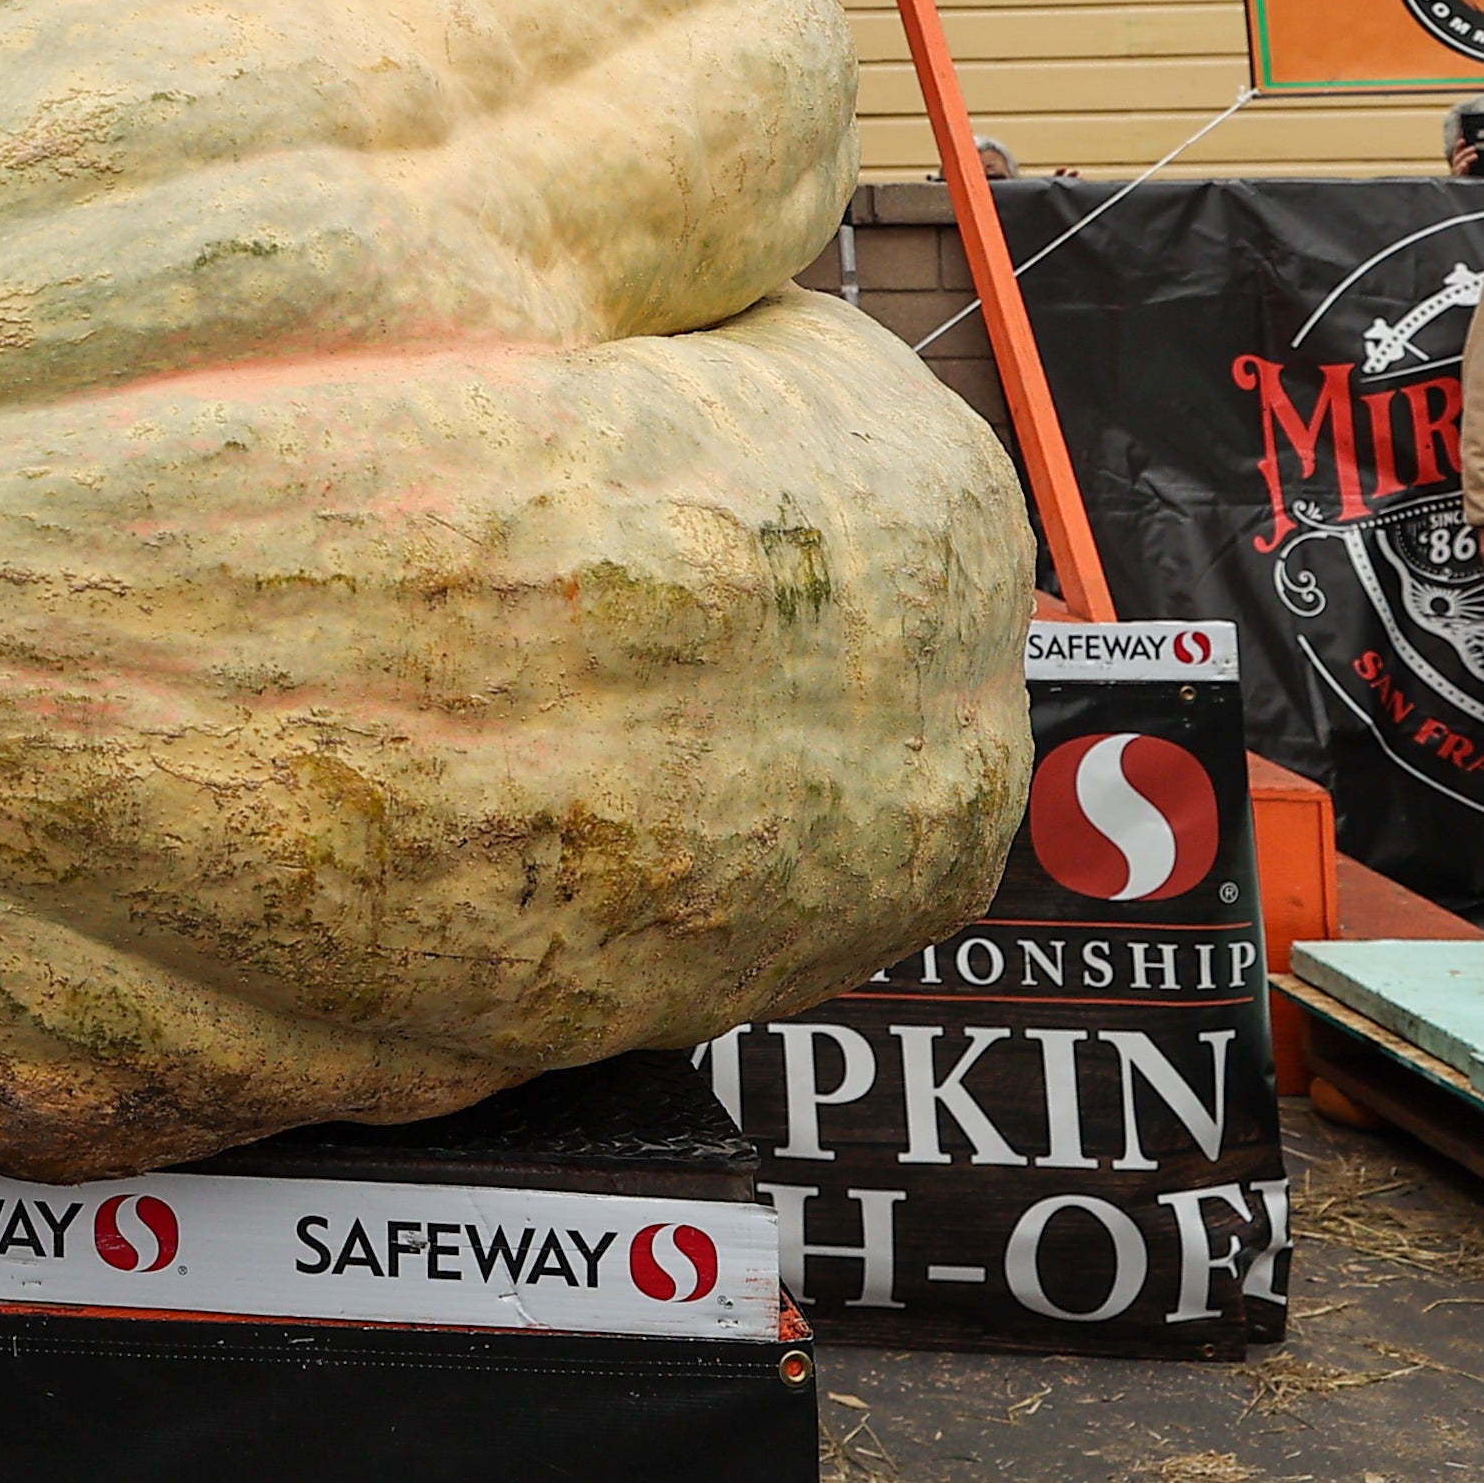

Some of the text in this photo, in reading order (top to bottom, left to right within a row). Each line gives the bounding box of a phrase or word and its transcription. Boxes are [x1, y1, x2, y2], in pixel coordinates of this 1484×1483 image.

[1028, 632, 1167, 663] SAFEWAY
[1353, 649, 1416, 724] SAN
[871, 937, 1258, 991] IONSHIP
[294, 1214, 618, 1291] SAFEWAY
